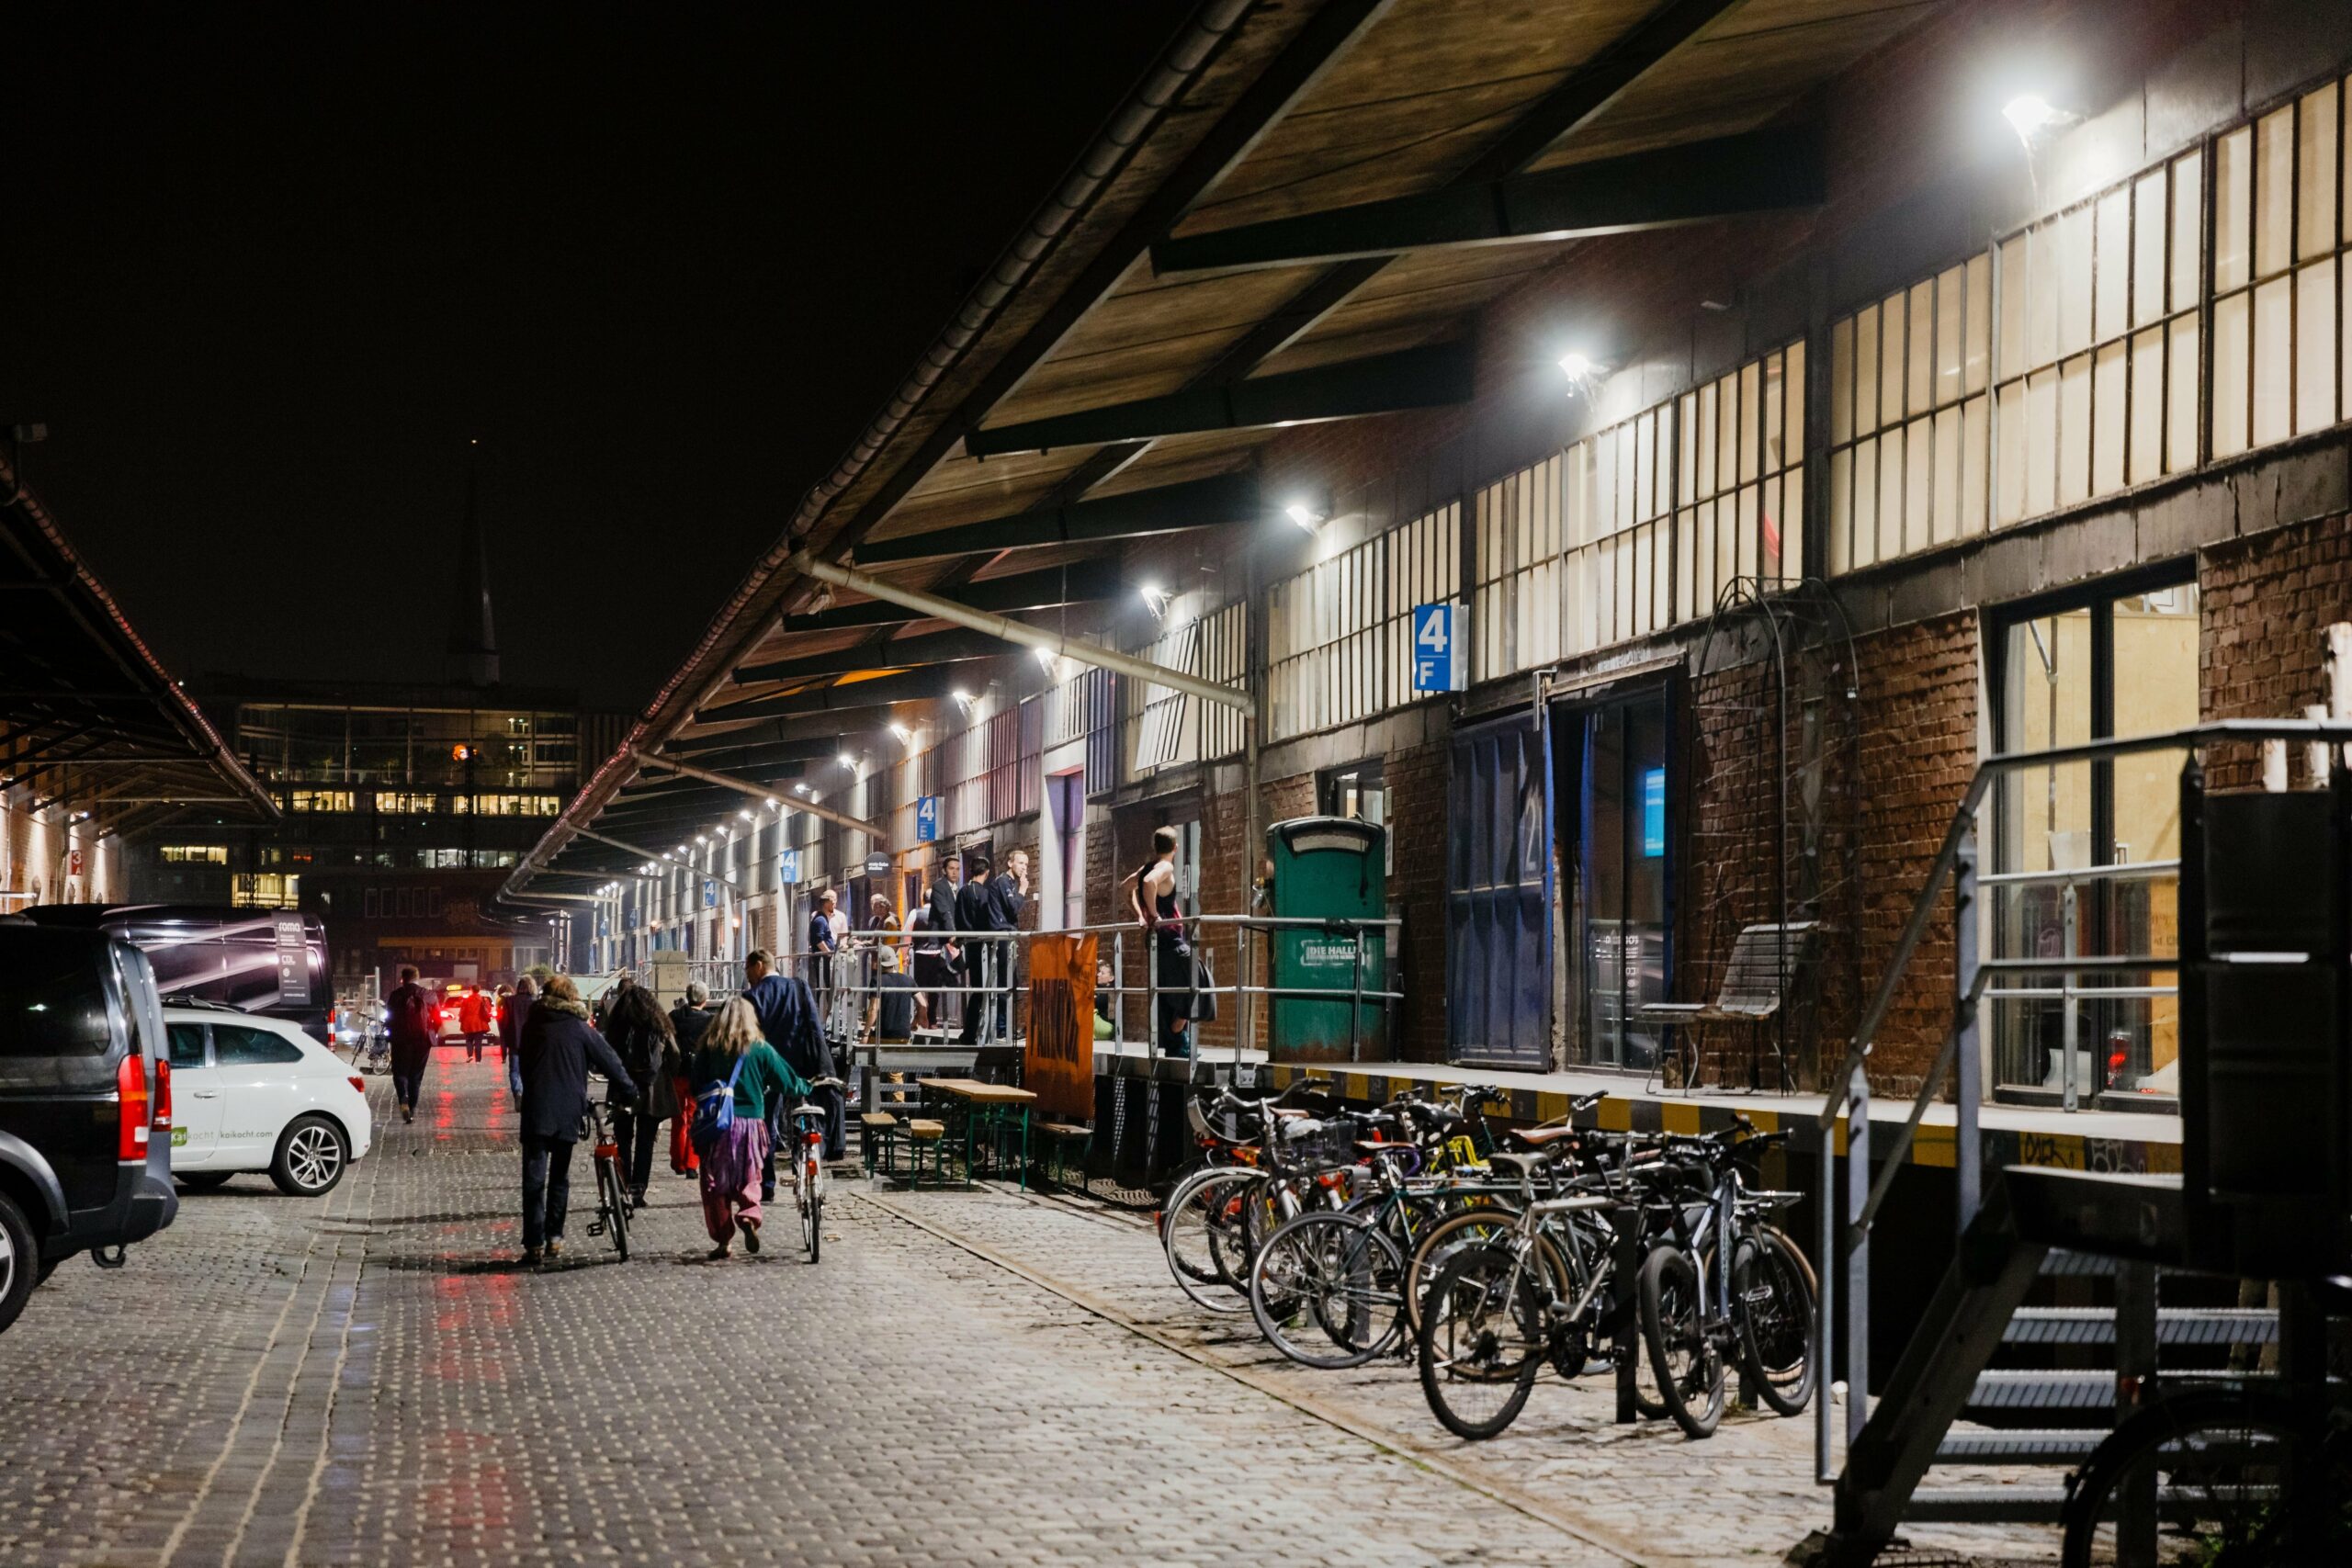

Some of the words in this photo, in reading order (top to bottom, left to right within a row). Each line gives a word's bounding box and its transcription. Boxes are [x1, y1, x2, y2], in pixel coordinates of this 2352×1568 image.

[1419, 609, 1448, 652] 4
[1419, 661, 1434, 686] F
[920, 799, 934, 821] 4
[920, 825, 928, 838] E
[73, 851, 82, 864] 3
[784, 851, 796, 868] 4
[706, 882, 715, 896] 4
[278, 922, 300, 932] roma
[220, 1130, 273, 1140] kaikocht.com
